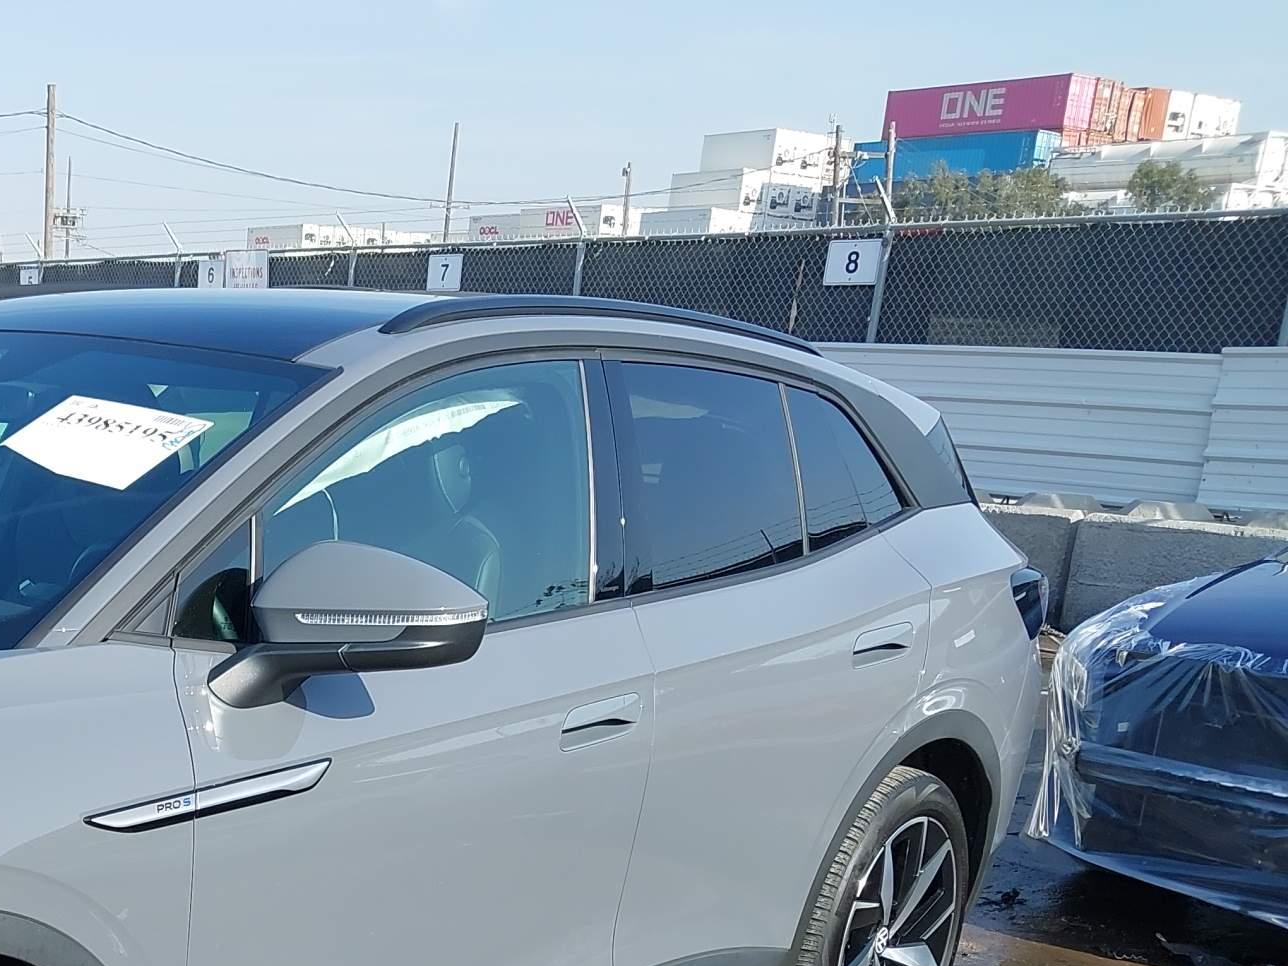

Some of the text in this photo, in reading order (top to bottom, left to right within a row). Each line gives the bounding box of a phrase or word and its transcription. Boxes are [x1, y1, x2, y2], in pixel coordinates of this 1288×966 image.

[941, 88, 1006, 120] ONE
[545, 209, 574, 227] ONE
[480, 226, 499, 236] OOCL
[845, 251, 859, 273] 8
[207, 268, 215, 284] 6
[440, 264, 449, 281] 7
[57, 412, 168, 442] 43985195
[157, 797, 191, 814] PRO S
